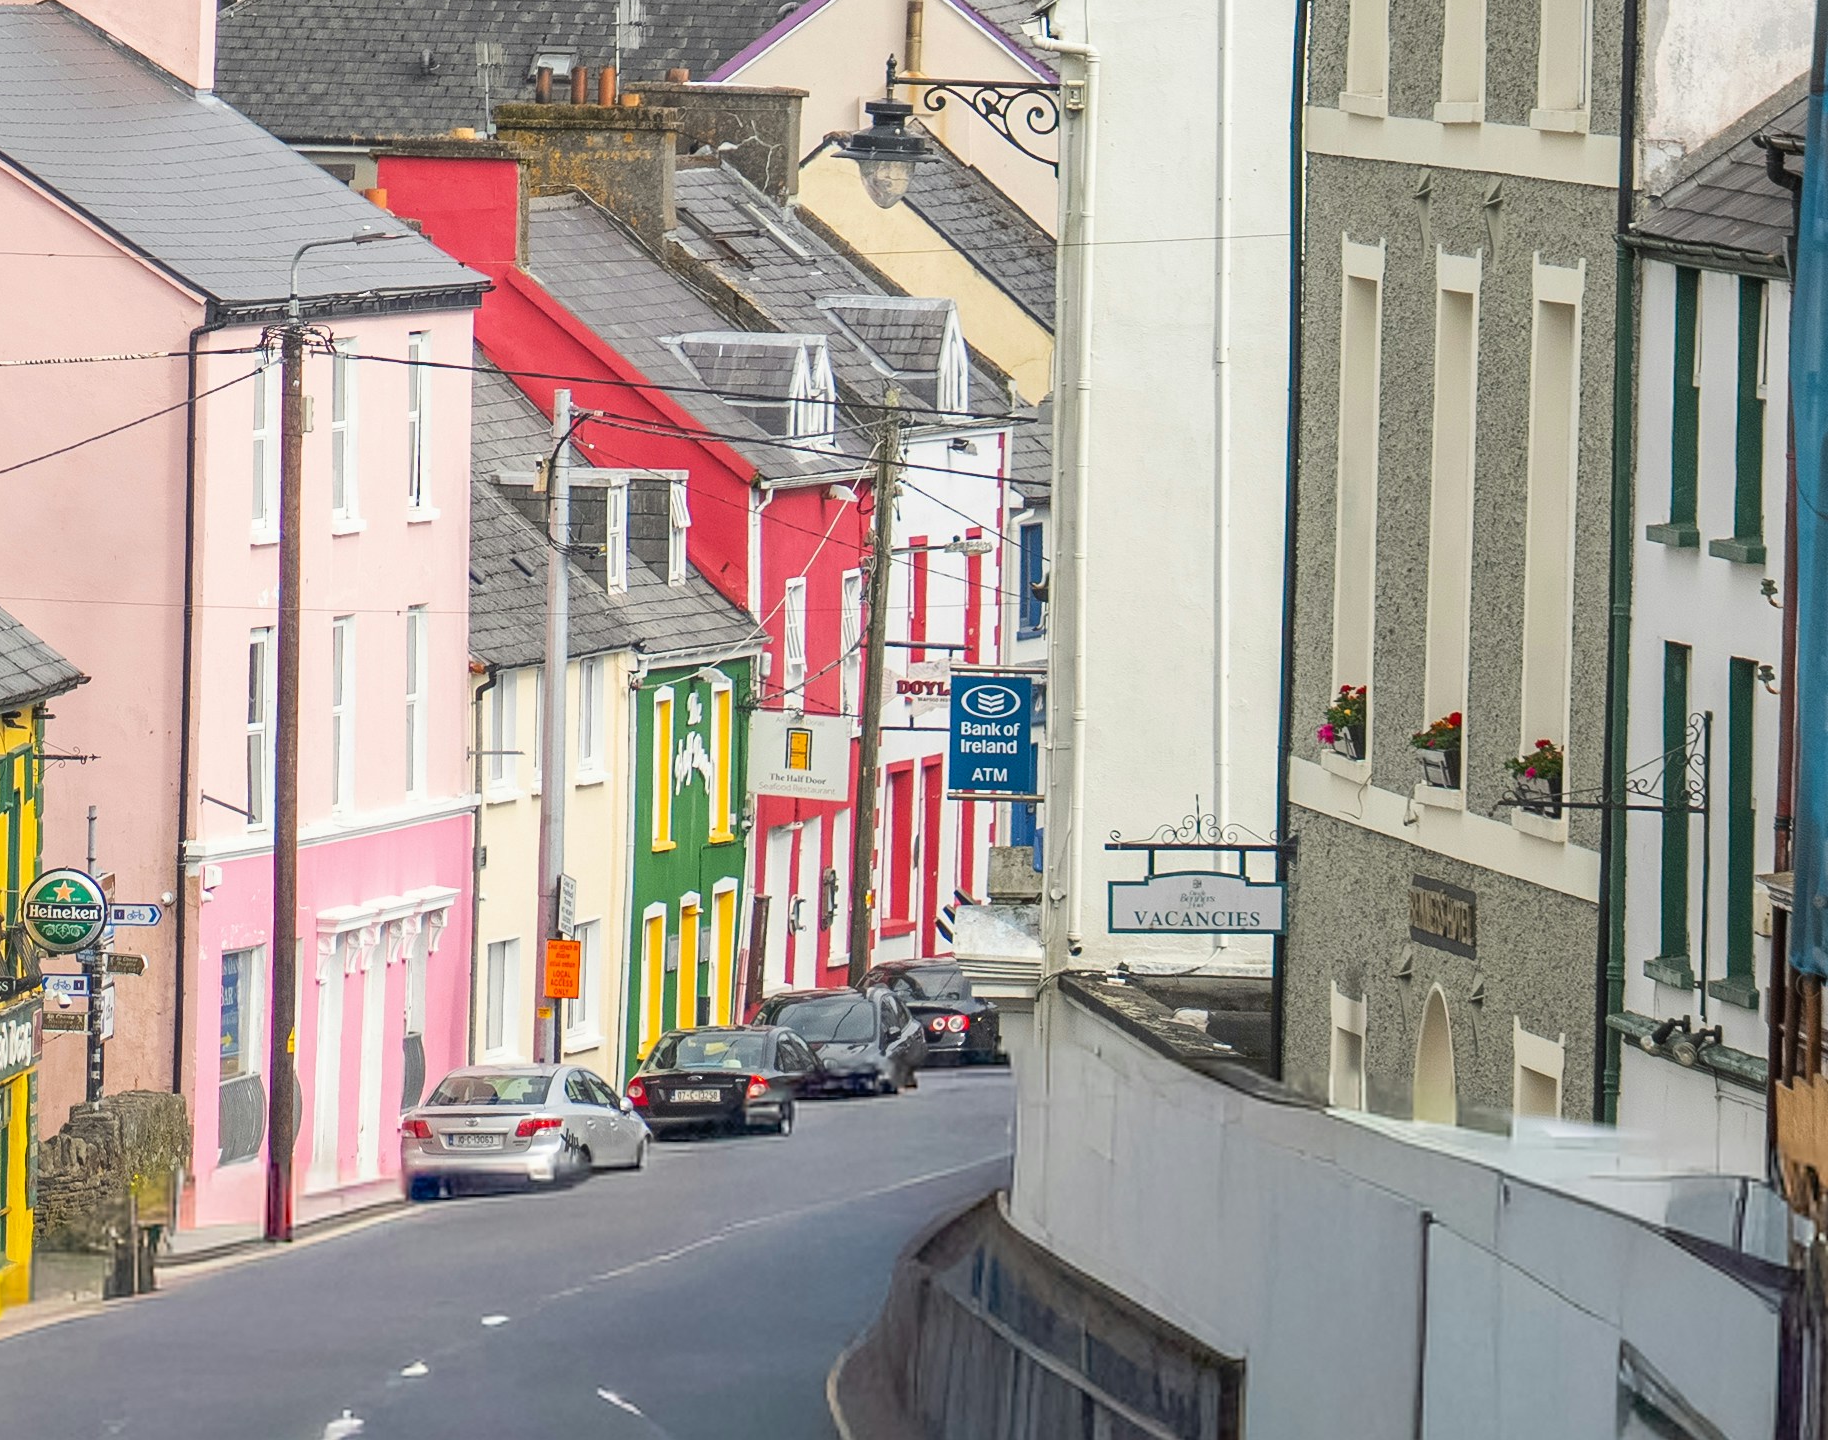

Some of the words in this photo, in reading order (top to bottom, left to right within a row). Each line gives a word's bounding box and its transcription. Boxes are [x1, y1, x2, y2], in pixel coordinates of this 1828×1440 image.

[896, 680, 951, 696] DOYL
[960, 721, 1001, 736] Bank
[1003, 723, 1021, 737] of
[960, 739, 1018, 754] Ireland
[770, 773, 785, 782] The
[787, 775, 804, 783] Half
[805, 776, 827, 785] Door
[971, 768, 1008, 782] ATM
[28, 904, 99, 920] Heineken
[1134, 911, 1260, 927] VACANCIES
